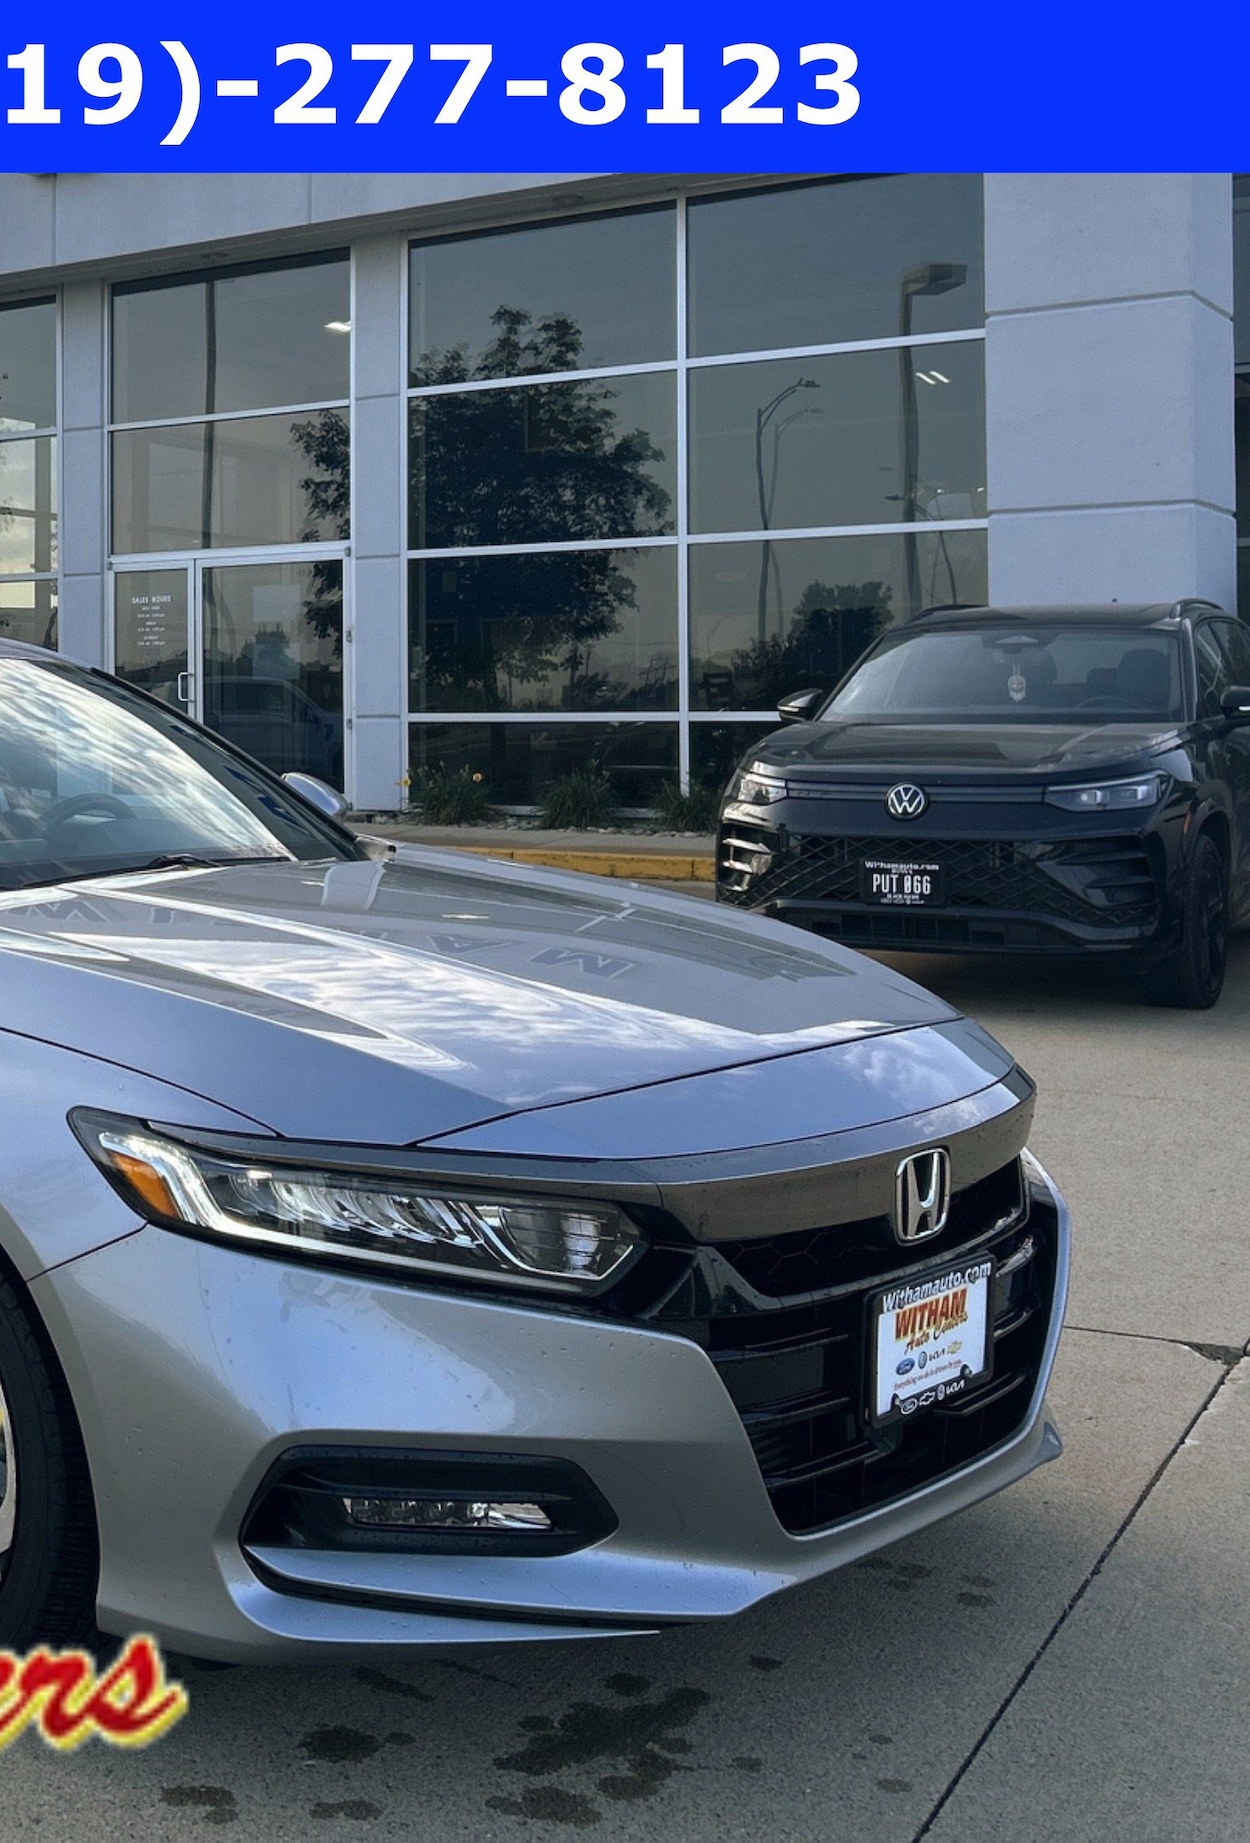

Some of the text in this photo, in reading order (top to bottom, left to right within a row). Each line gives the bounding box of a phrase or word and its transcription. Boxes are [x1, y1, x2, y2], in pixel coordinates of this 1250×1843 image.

[872, 873, 899, 893] PUT
[882, 1261, 992, 1314] Withamauto.com
[894, 1287, 968, 1342] WITHAM
